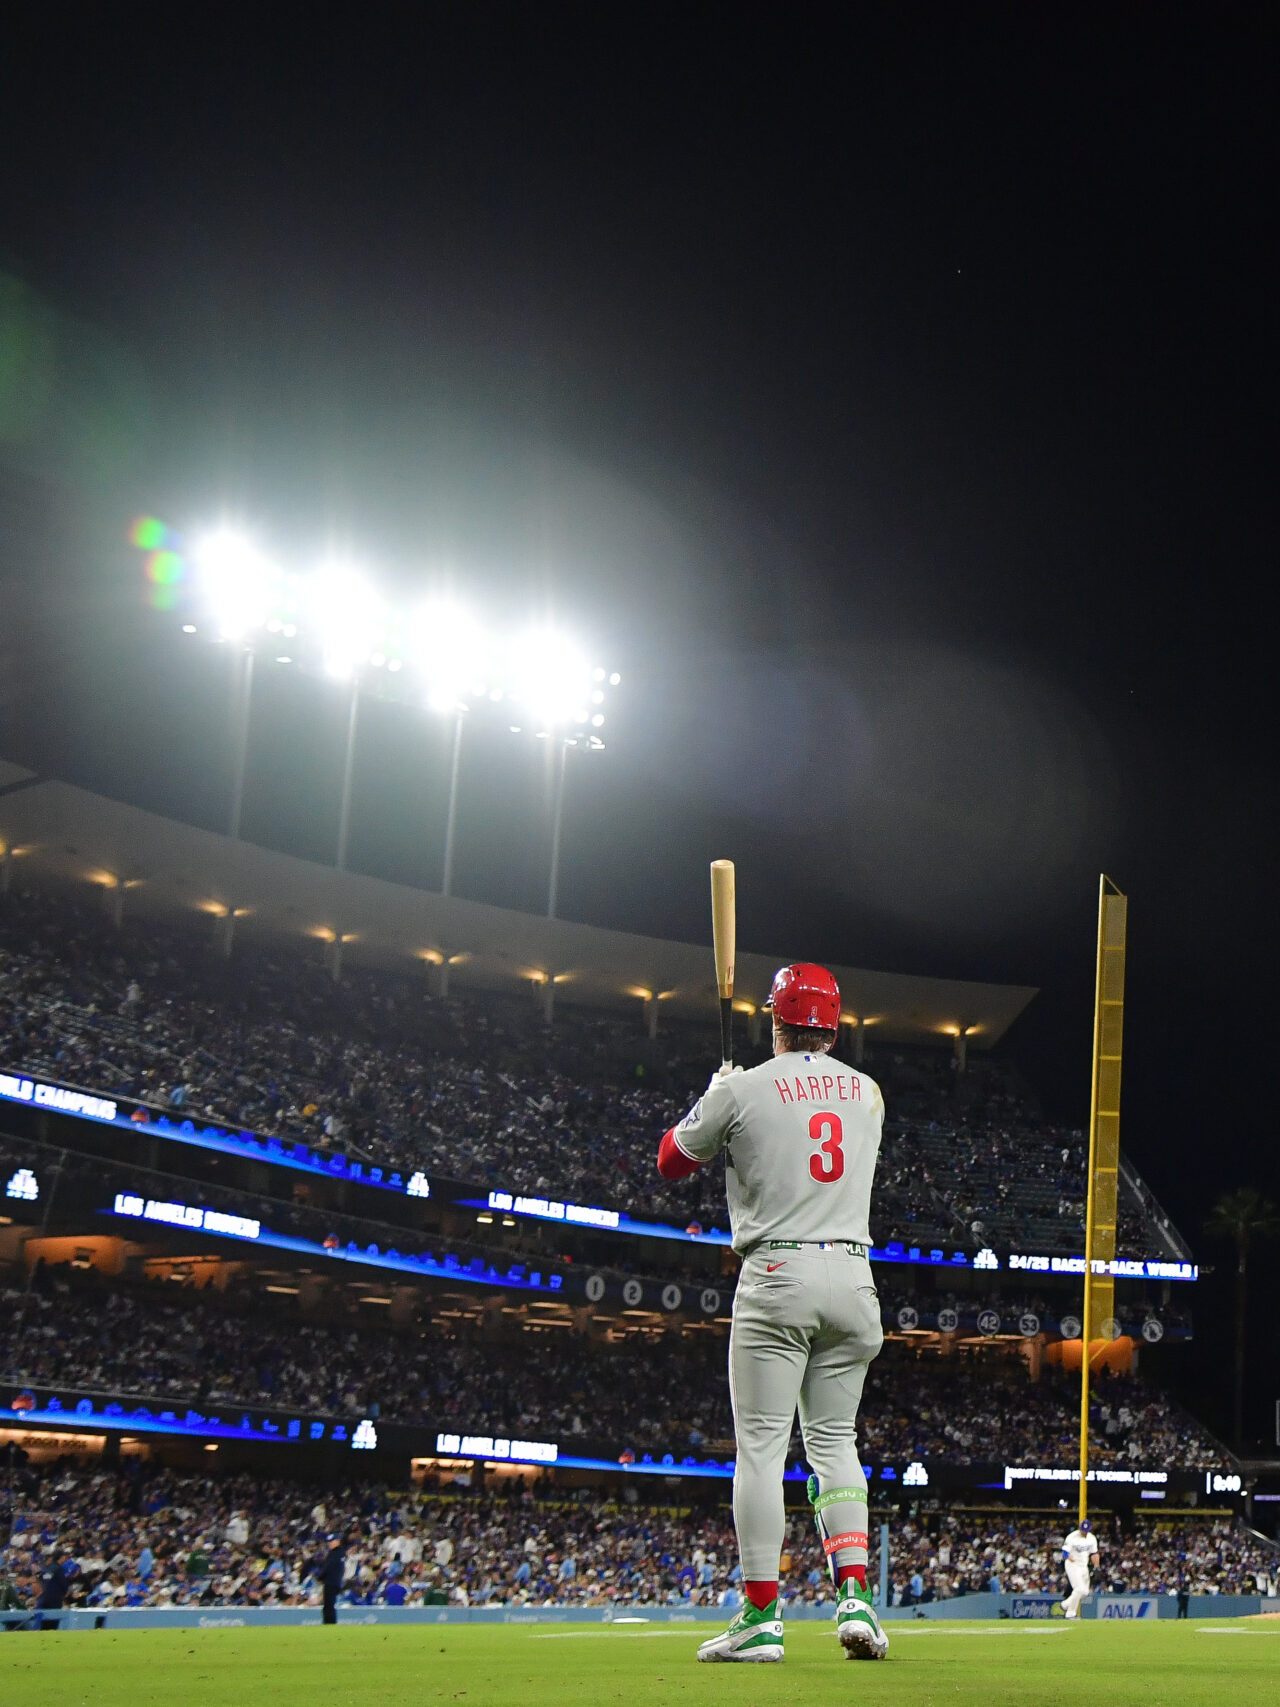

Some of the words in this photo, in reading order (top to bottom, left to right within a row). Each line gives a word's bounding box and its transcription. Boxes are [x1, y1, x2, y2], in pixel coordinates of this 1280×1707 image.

[774, 1075, 862, 1104] HARPER
[807, 1110, 845, 1185] 3
[1009, 1255, 1049, 1270] 24/25
[900, 1310, 916, 1325] 34
[940, 1310, 956, 1326] 39
[980, 1315, 997, 1330] 42
[1021, 1318, 1038, 1333] 53
[1103, 1604, 1134, 1619] ANA
